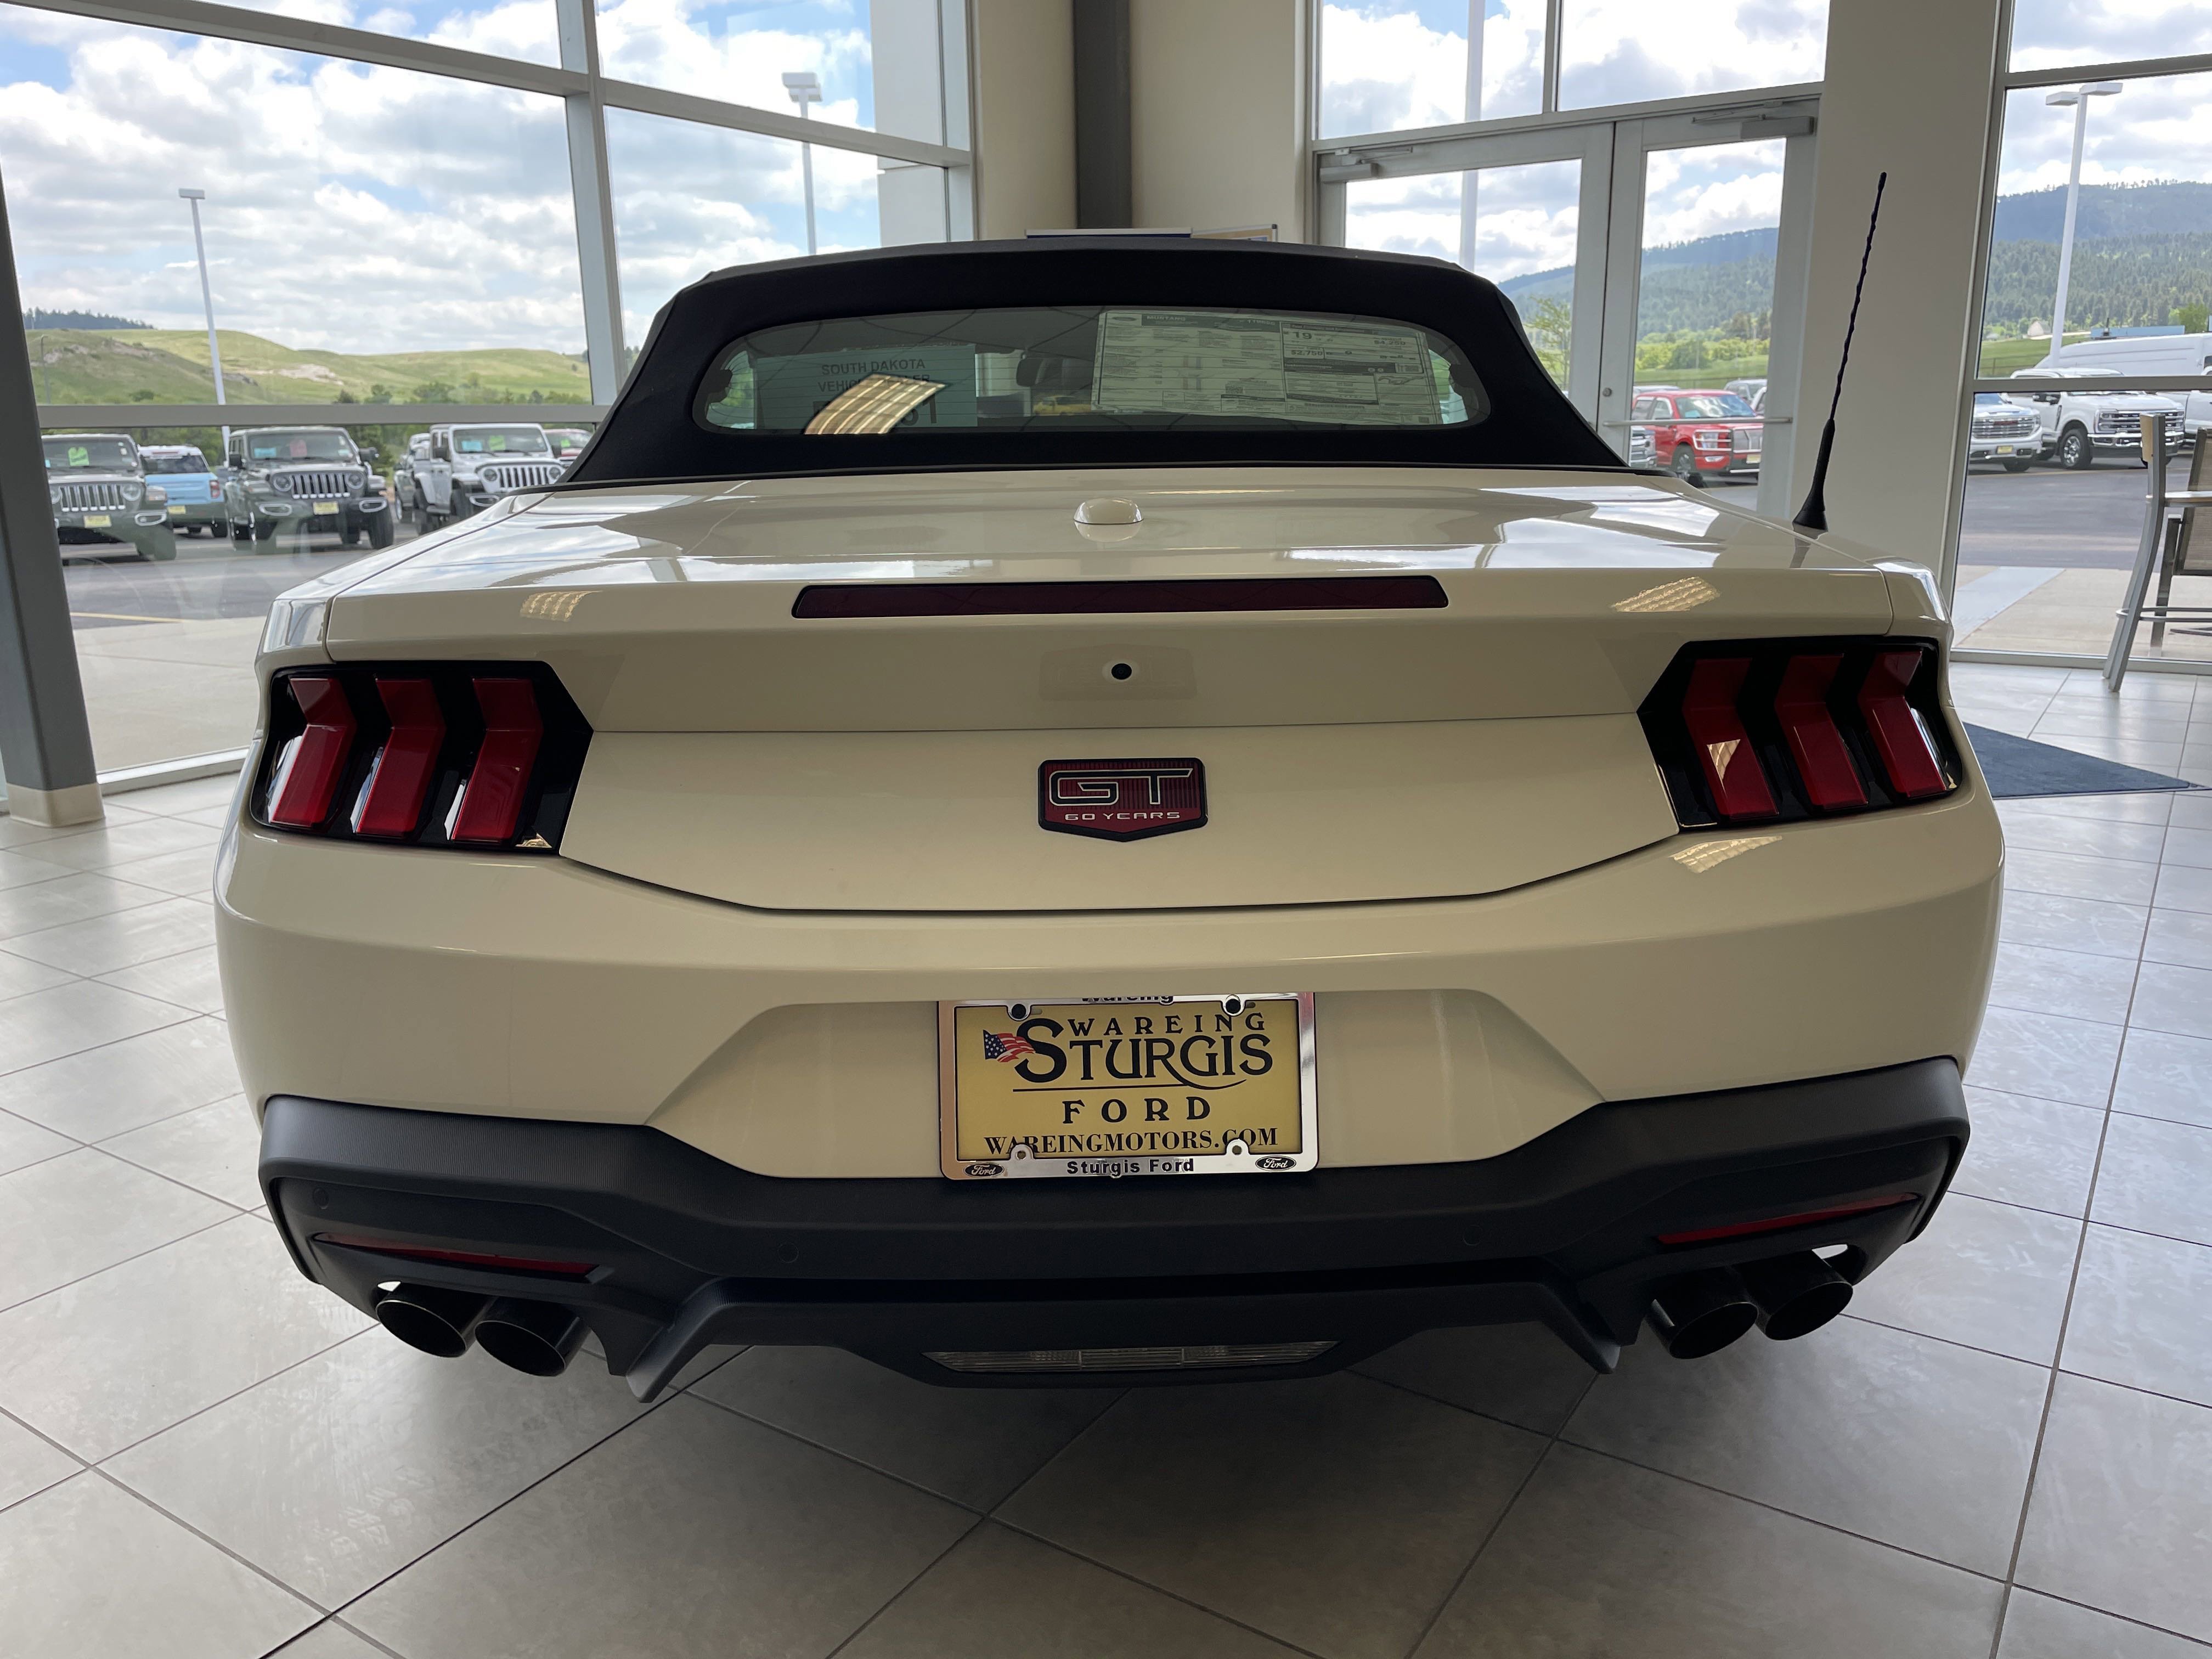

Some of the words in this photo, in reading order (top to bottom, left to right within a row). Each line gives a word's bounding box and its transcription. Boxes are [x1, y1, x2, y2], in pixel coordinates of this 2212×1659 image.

[822, 363, 867, 375] SOUTH
[871, 358, 926, 371] DAKOTA
[1049, 768, 1193, 806] GT
[1103, 812, 1181, 820] YEARS
[1067, 1012, 1265, 1036] WAREING
[1014, 1018, 1273, 1090] STURGIS
[1062, 1096, 1211, 1124] FORD
[984, 1127, 1278, 1155] WAREINGMOTORS.COM
[971, 1164, 997, 1176] Ford
[1066, 1160, 1140, 1177] Sturgis
[1149, 1158, 1194, 1172] Ford
[1263, 1157, 1288, 1169] Ford
